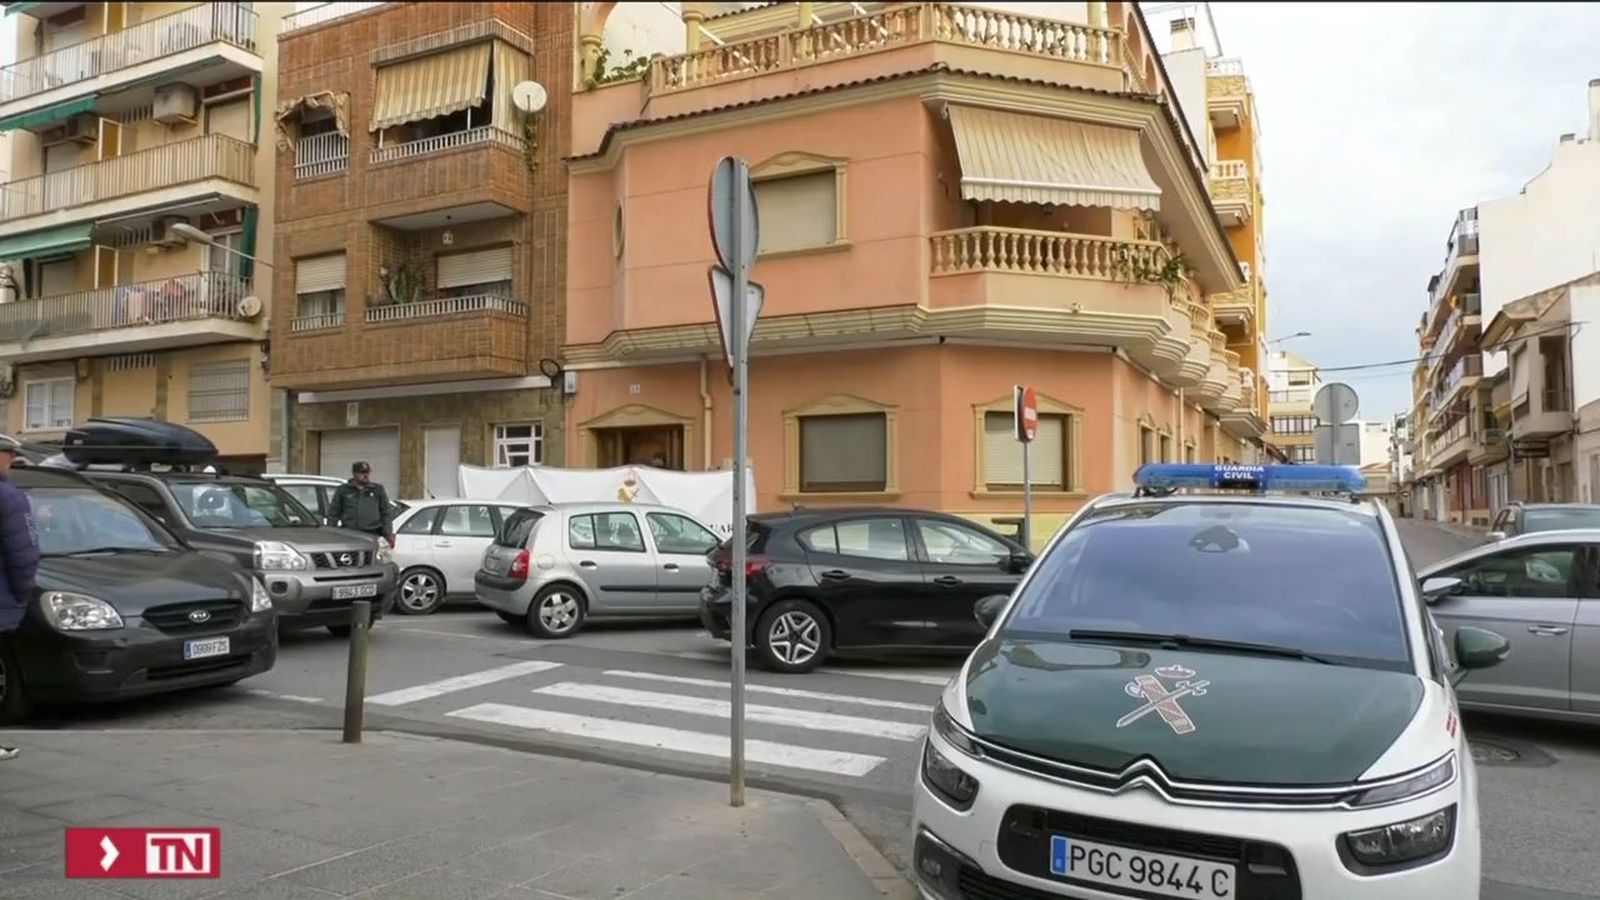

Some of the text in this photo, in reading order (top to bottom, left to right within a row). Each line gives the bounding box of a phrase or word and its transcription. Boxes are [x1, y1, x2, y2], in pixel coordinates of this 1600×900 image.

[1223, 471, 1254, 479] CIVIL
[1070, 845, 1229, 897] PGC 9844 C
